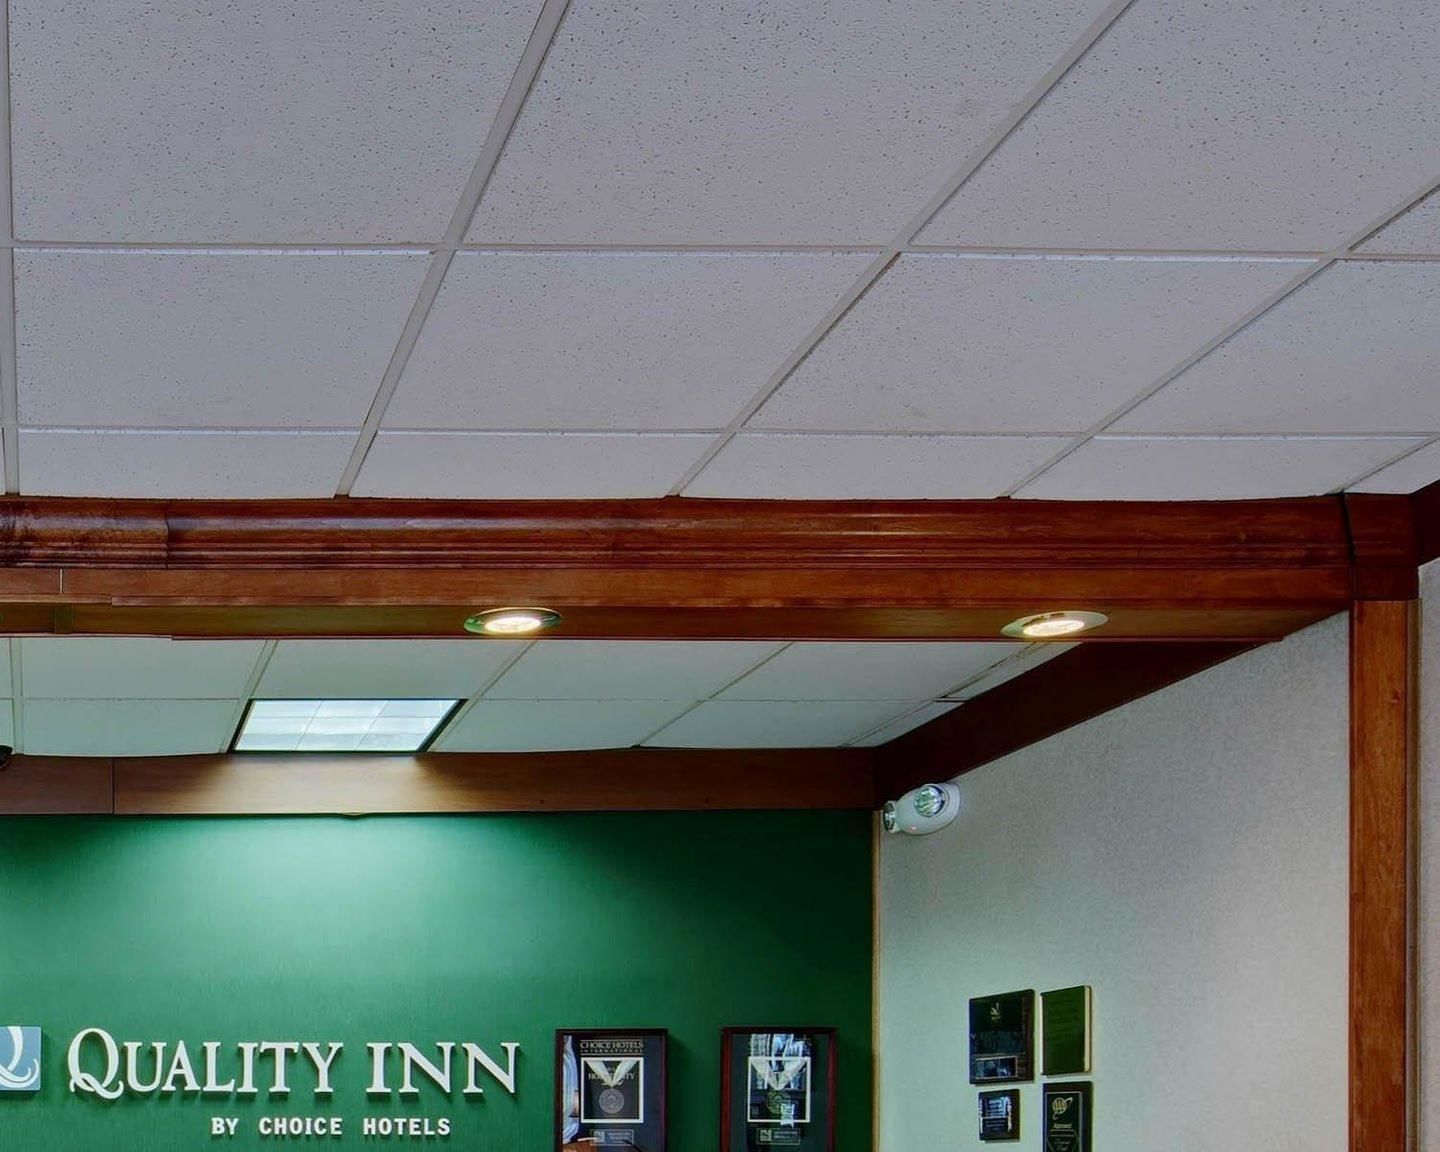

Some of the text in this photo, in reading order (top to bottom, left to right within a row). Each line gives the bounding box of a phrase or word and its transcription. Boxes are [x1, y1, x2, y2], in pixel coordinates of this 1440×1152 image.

[67, 1027, 520, 1100] QUALITY INN
[211, 1117, 451, 1136] BY CHOICE HOTELS
